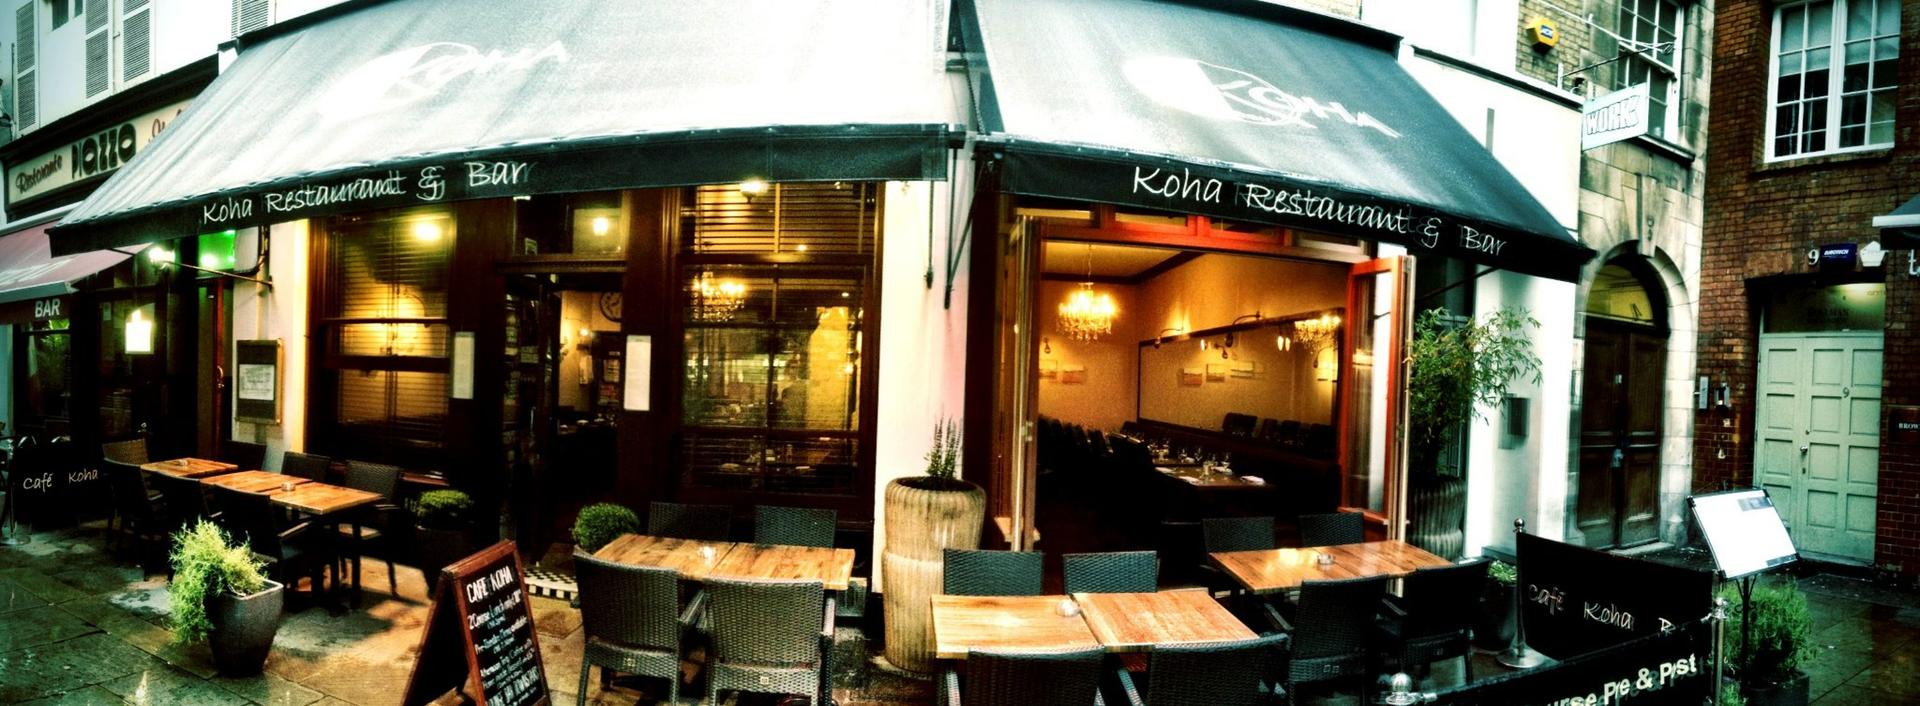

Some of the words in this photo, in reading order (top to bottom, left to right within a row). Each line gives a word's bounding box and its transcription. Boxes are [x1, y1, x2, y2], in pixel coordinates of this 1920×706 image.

[203, 196, 252, 224] Koha
[266, 170, 406, 213] Restaurant
[417, 166, 445, 200] &
[466, 161, 531, 187] Bar
[1133, 166, 1221, 204] Koha
[1247, 184, 1408, 236] Restaurant
[1424, 217, 1441, 249] &
[1465, 225, 1507, 257] Bar
[1807, 249, 1820, 266] 9
[35, 300, 60, 318] BAR
[69, 468, 98, 484] Koha
[1583, 601, 1632, 631] Koha
[1636, 668, 1654, 690] &
